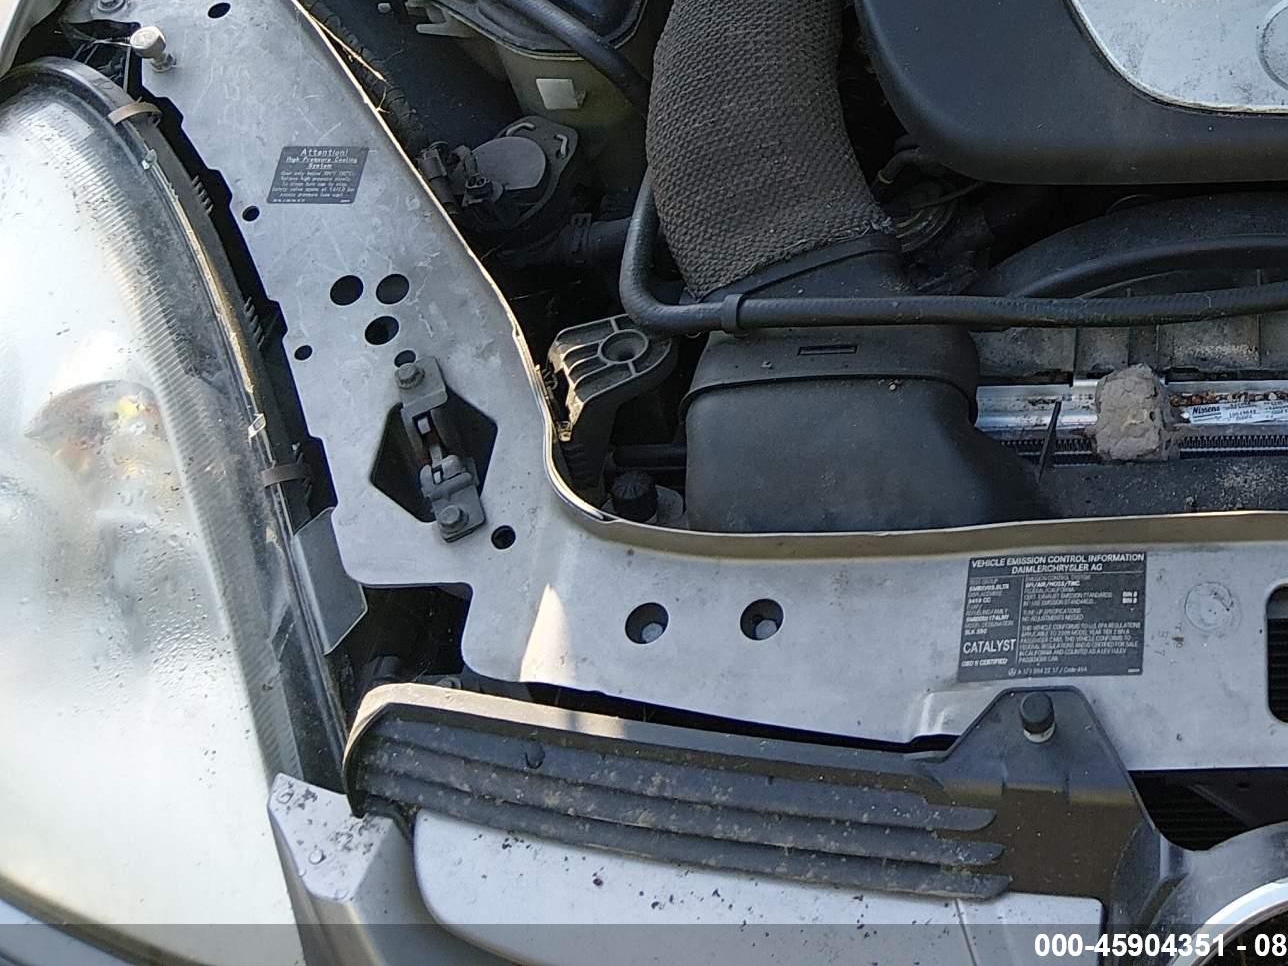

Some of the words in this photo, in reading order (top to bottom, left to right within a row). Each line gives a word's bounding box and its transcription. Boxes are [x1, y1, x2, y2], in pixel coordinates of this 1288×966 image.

[300, 148, 349, 157] Attention!
[335, 156, 358, 164] Cooling
[971, 558, 1006, 568] VEHICLE
[1006, 556, 1046, 566] EMISSION
[1047, 555, 1087, 565] CONTROL
[1088, 553, 1145, 563] INFORMATION
[1011, 563, 1089, 575] DAIMLERCHRYSLER
[1091, 563, 1103, 571] AG
[963, 638, 1017, 654] CATALYST
